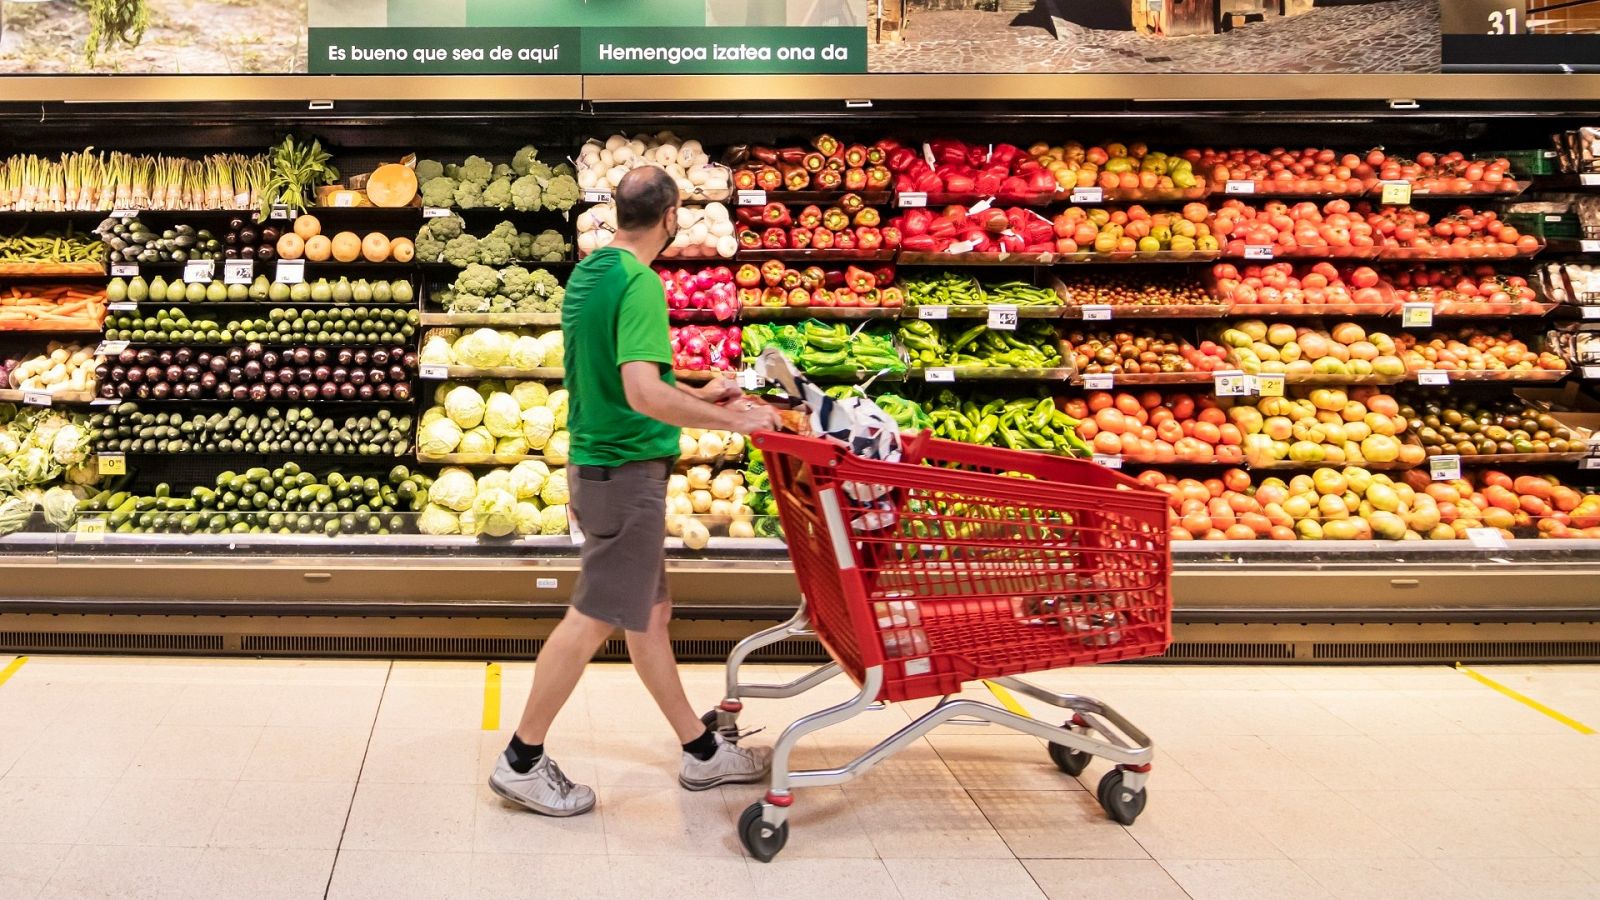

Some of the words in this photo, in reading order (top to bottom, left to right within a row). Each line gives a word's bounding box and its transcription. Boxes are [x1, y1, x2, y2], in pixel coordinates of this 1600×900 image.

[1486, 7, 1518, 35] 31
[328, 45, 347, 61] Es
[351, 45, 409, 61] bueno
[412, 48, 448, 64] que
[451, 48, 485, 61] sea
[488, 45, 513, 61] de
[517, 43, 560, 64] aquí
[599, 43, 708, 65] Hemengoa
[712, 43, 772, 61] izatea
[776, 46, 816, 61] ona
[820, 44, 848, 61] da
